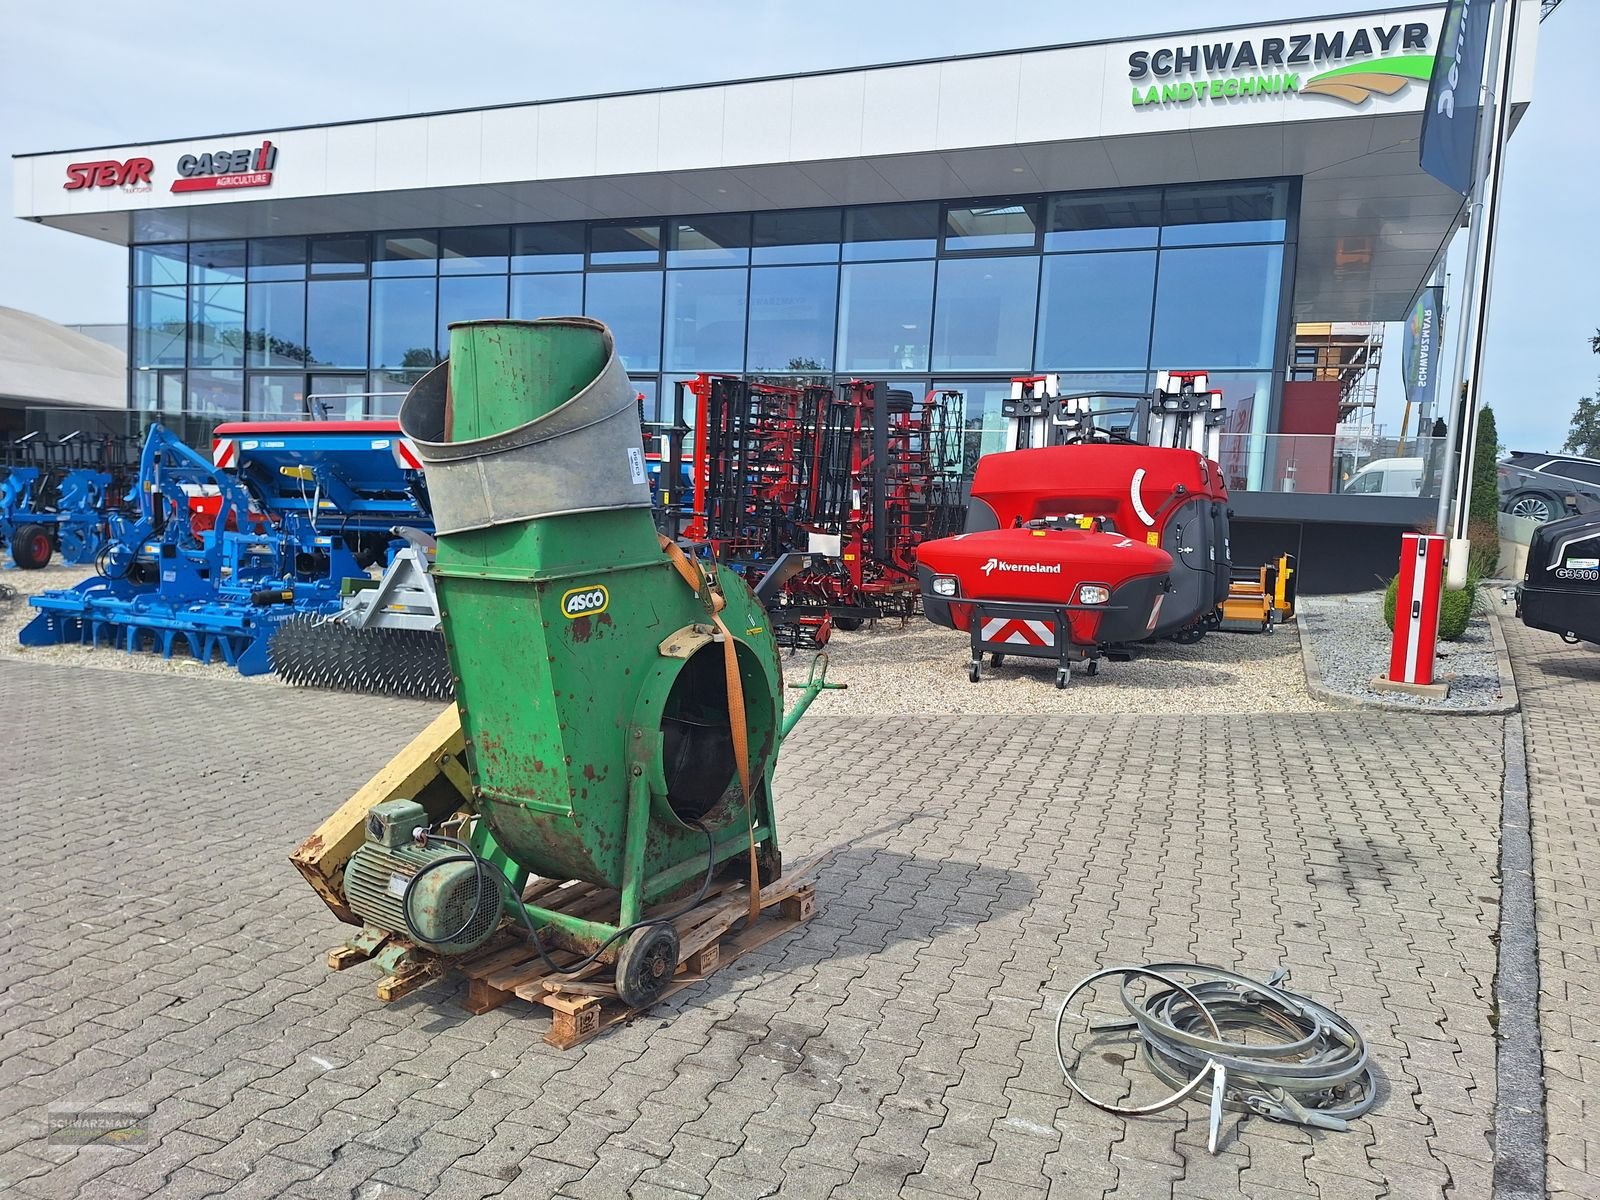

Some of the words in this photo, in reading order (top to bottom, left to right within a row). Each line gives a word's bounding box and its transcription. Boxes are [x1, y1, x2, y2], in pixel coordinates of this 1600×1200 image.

[1128, 22, 1429, 78] SCHWARZMAYR
[1131, 73, 1299, 106] LANDTECHNIK
[64, 157, 154, 190] STEYR
[177, 149, 251, 177] CASE
[216, 173, 268, 187] AGRICULTURE
[999, 561, 1061, 574] Kverneland
[1555, 568, 1599, 581] G3500
[567, 591, 604, 613] ASCO
